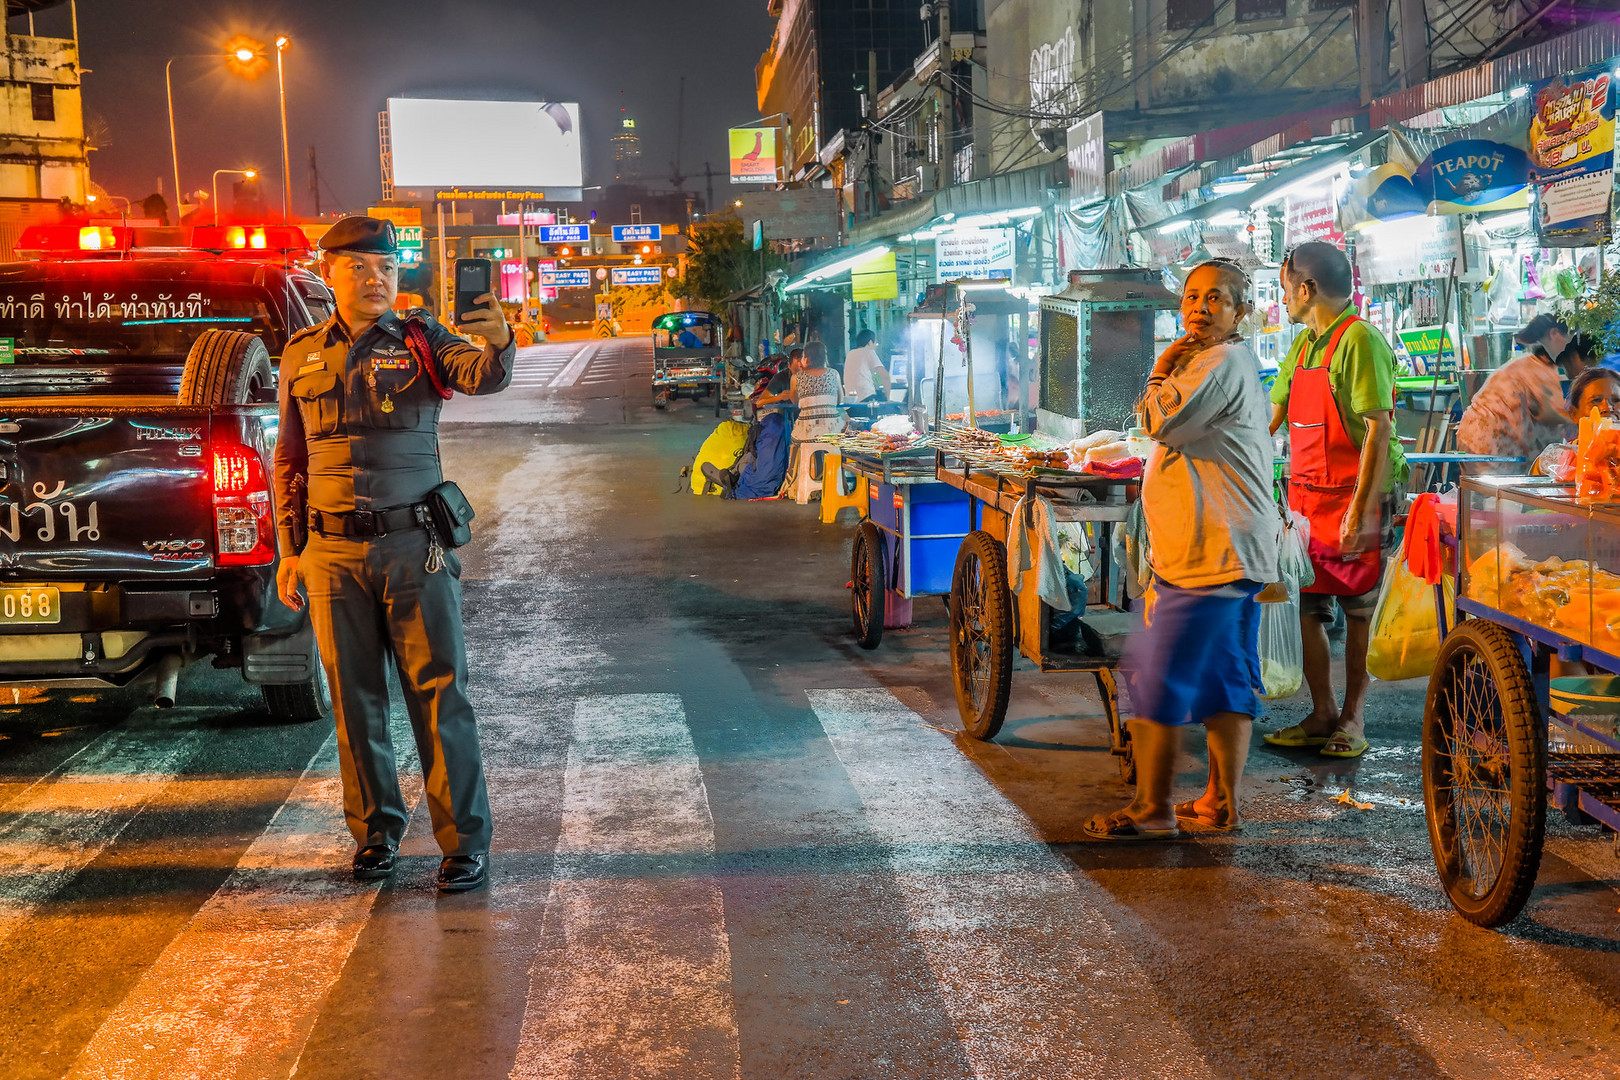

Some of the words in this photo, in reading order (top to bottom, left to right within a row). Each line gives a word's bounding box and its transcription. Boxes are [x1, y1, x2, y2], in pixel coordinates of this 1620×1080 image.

[1591, 74, 1610, 112] 2
[1432, 155, 1504, 176] TEAPOT
[468, 191, 474, 199] 3
[0, 293, 45, 319] ทำดี
[54, 291, 115, 319] ทำได้
[136, 427, 201, 440] HILUX
[142, 538, 206, 551] VIGO
[152, 552, 204, 562] CHAMP
[4, 593, 51, 618] 088
